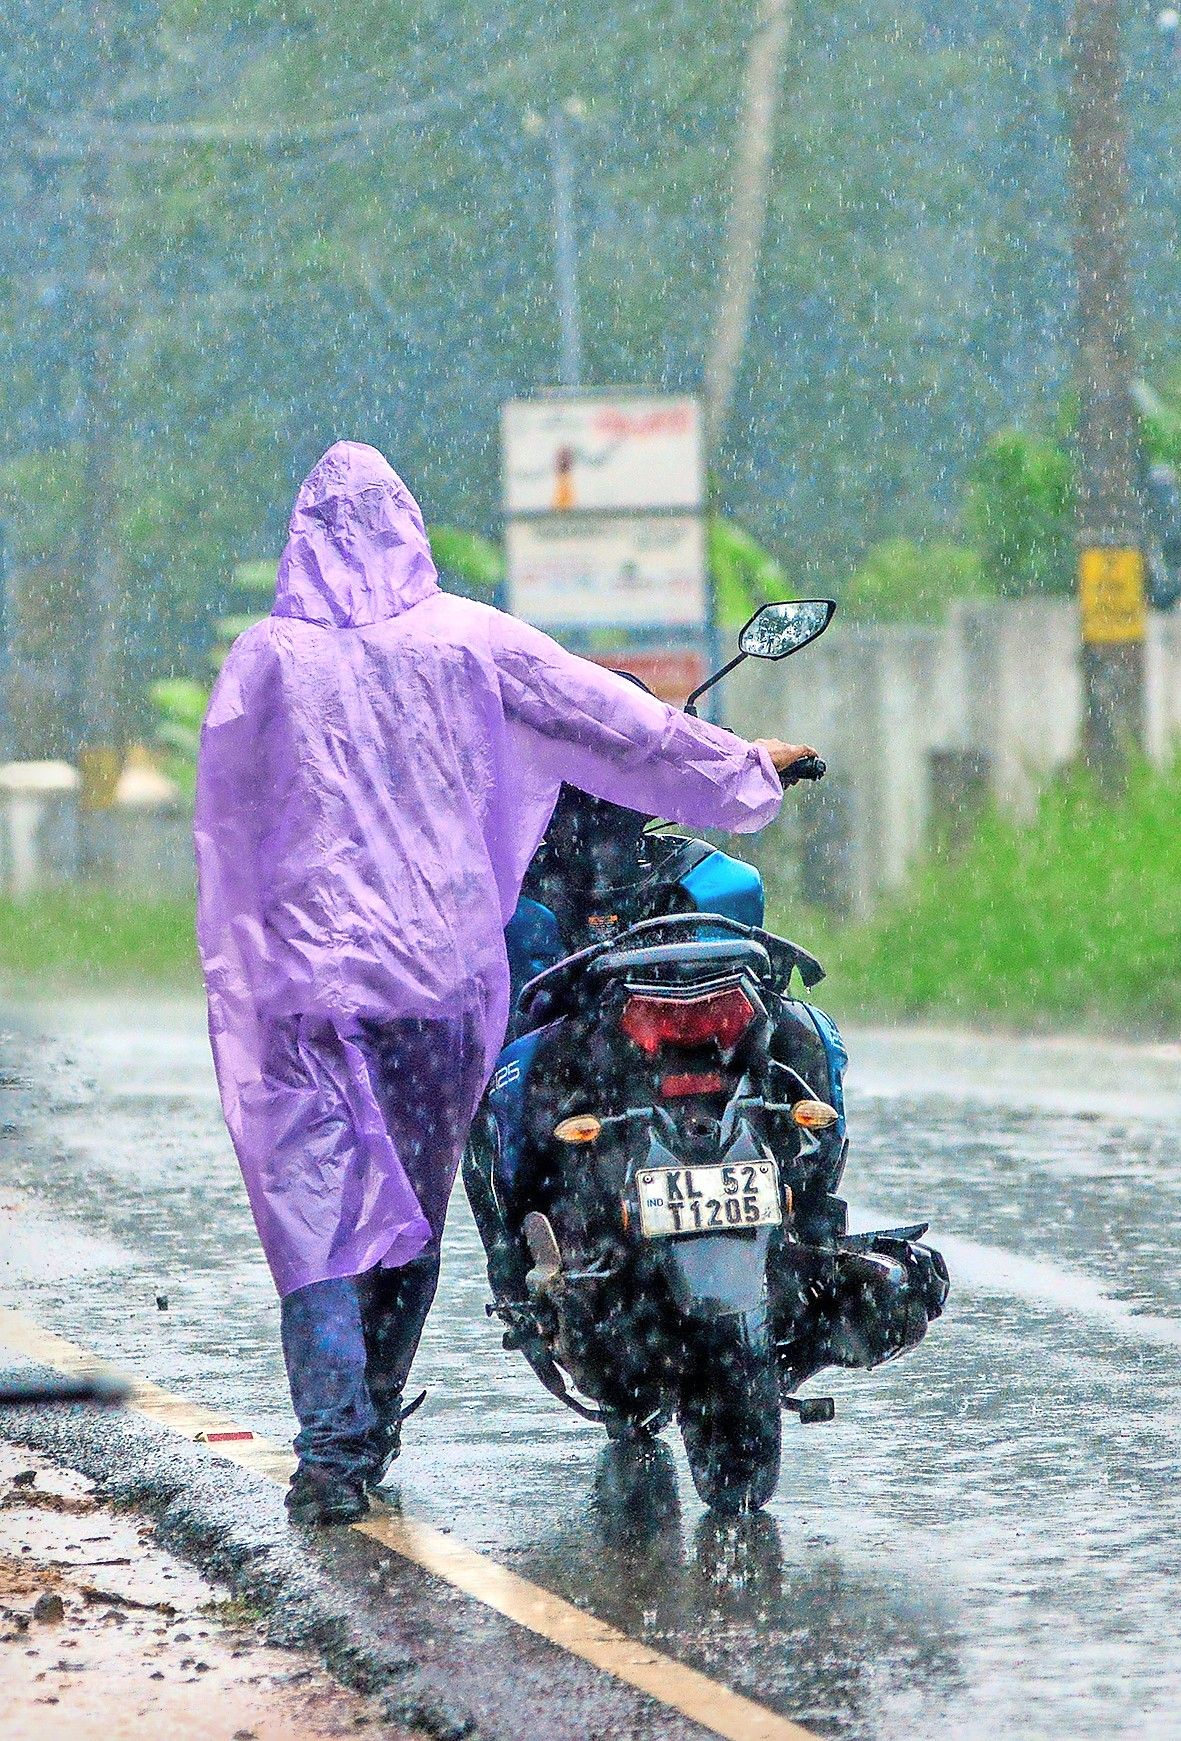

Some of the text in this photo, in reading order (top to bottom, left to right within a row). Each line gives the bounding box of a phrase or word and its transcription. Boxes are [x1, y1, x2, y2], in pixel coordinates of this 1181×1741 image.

[666, 1166, 759, 1201] KL 52
[646, 1198, 664, 1208] IND
[667, 1195, 761, 1231] T1205
